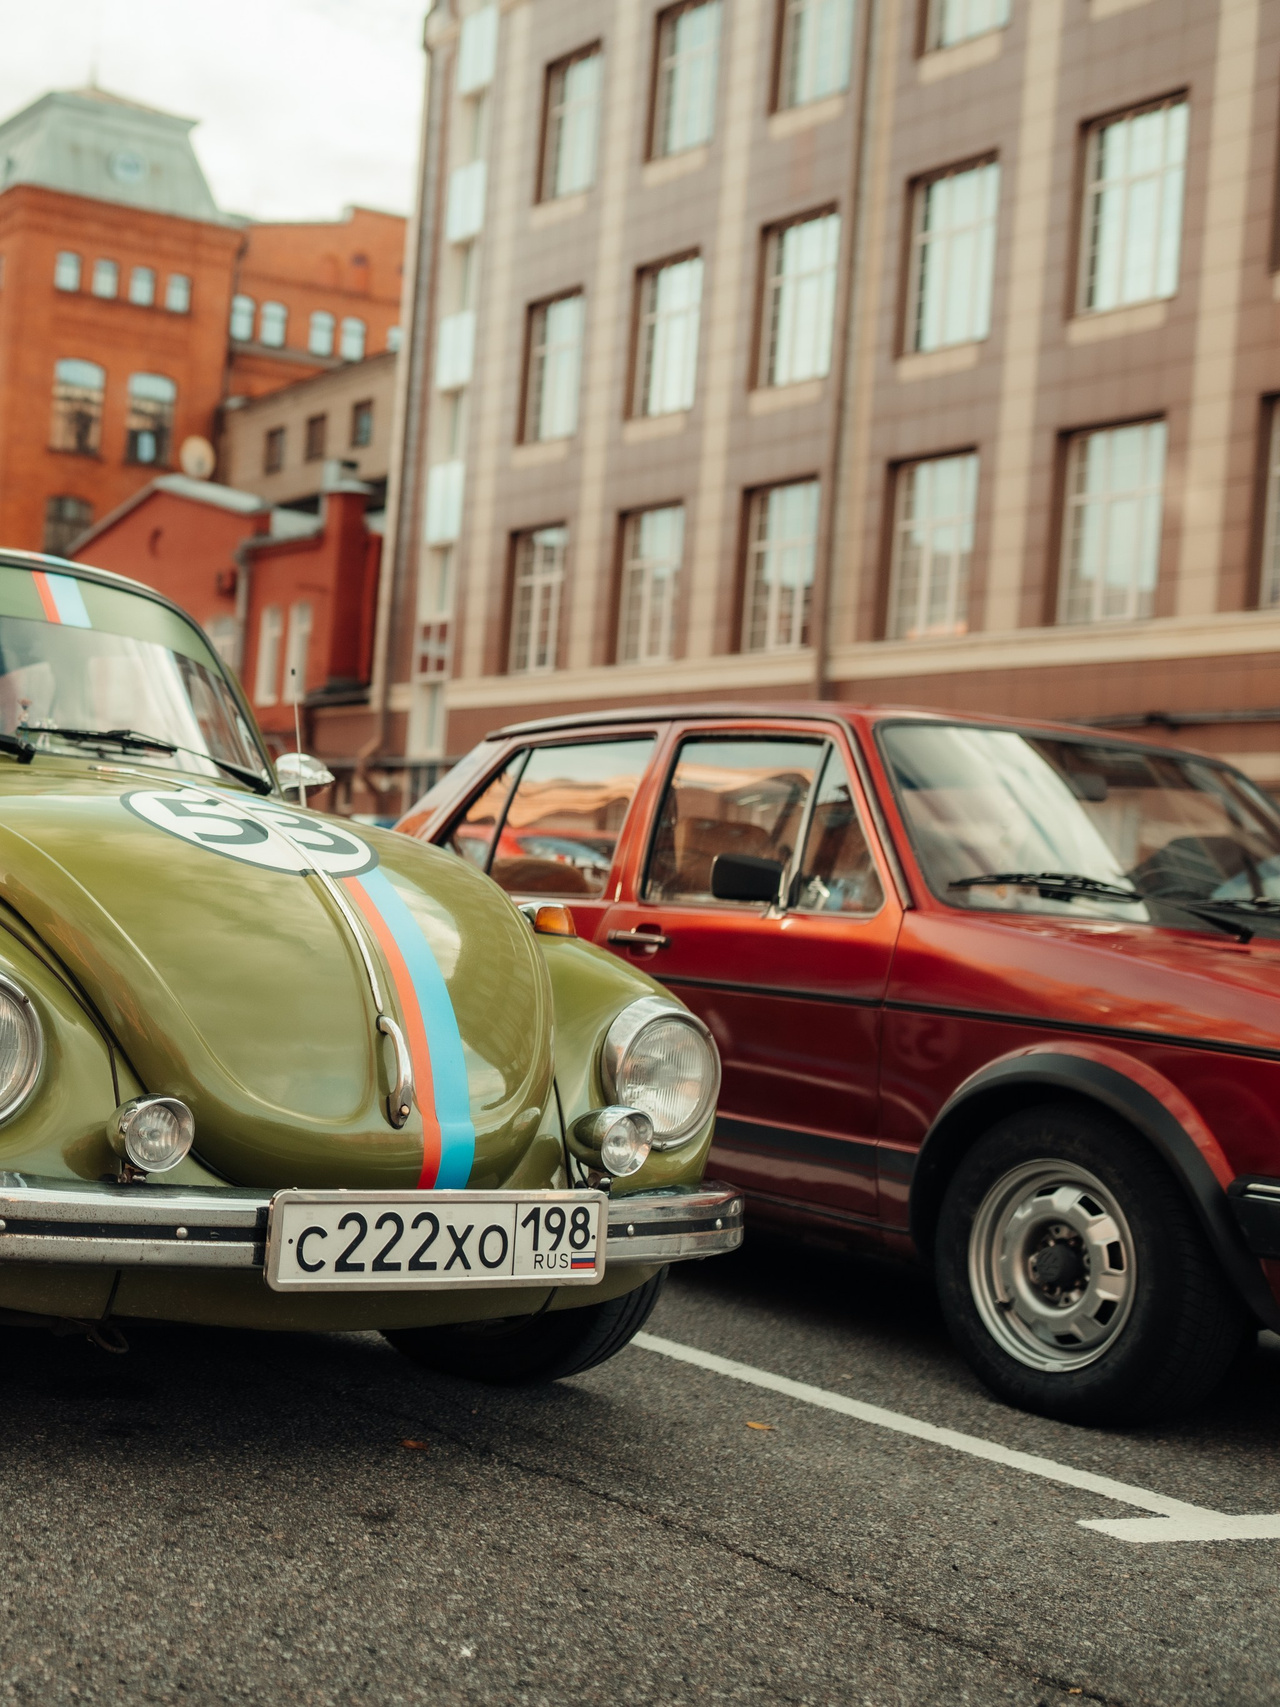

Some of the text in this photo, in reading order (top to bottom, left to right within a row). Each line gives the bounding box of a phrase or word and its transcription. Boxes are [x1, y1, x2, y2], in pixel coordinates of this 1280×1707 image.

[153, 797, 359, 855] 53
[295, 1206, 590, 1273] C222XO 198
[534, 1253, 569, 1269] RUS
